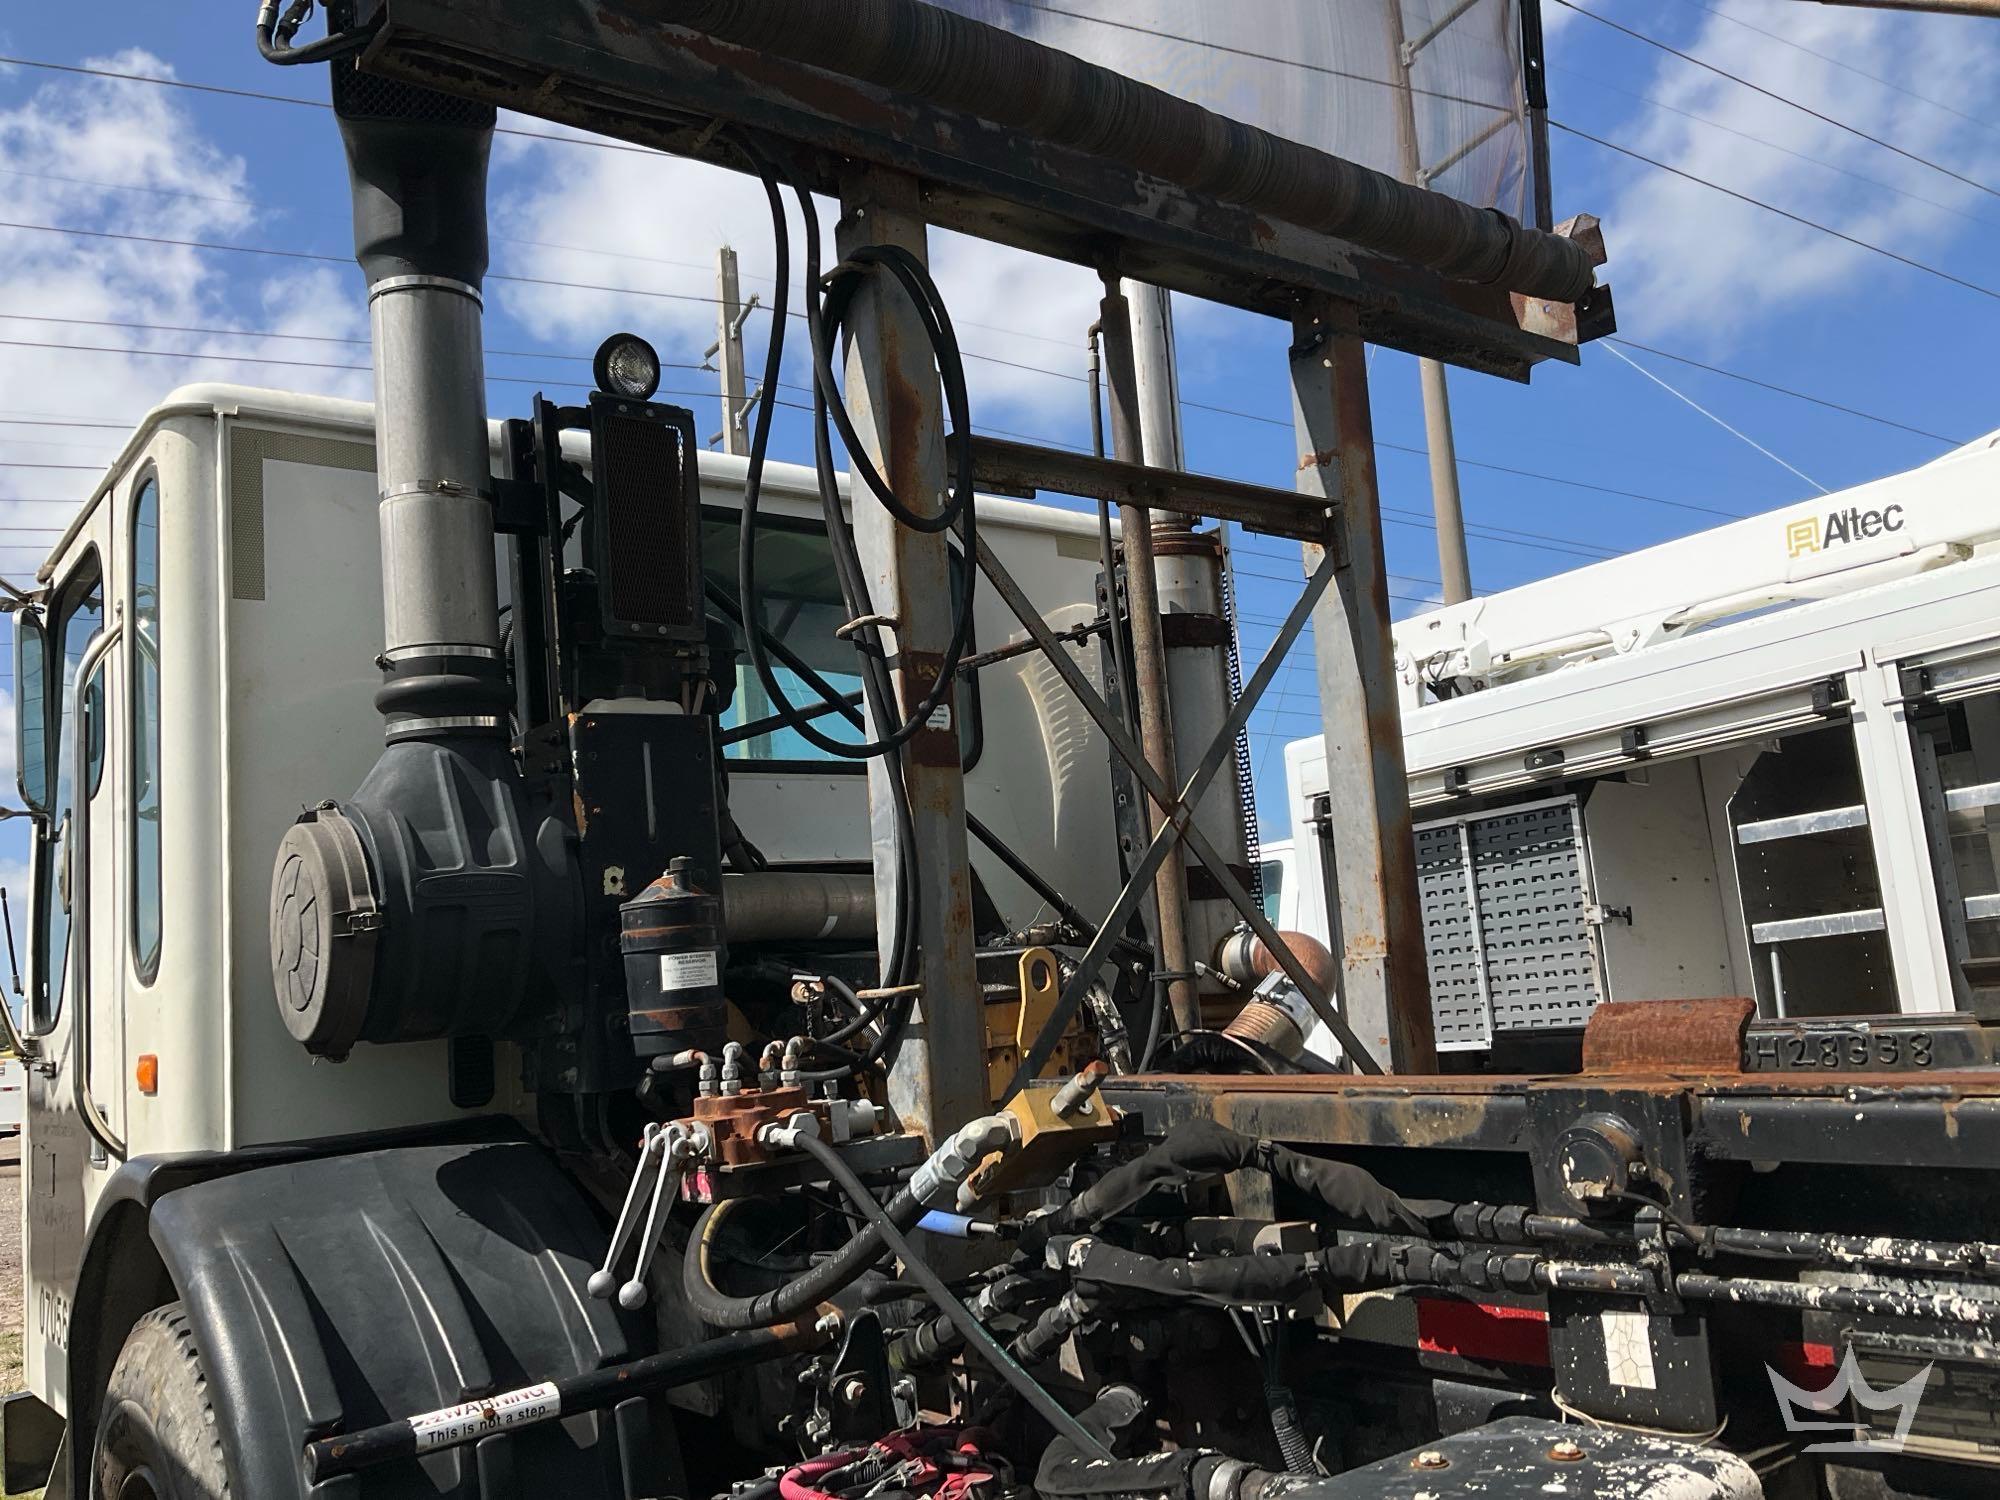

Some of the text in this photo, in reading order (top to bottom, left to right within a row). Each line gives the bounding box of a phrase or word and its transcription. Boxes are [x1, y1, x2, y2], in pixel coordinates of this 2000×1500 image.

[1823, 503, 1904, 549] Altec
[428, 1427, 458, 1443] This
[463, 1423, 474, 1435] is
[480, 1415, 501, 1431] not
[506, 1413, 513, 1424] a
